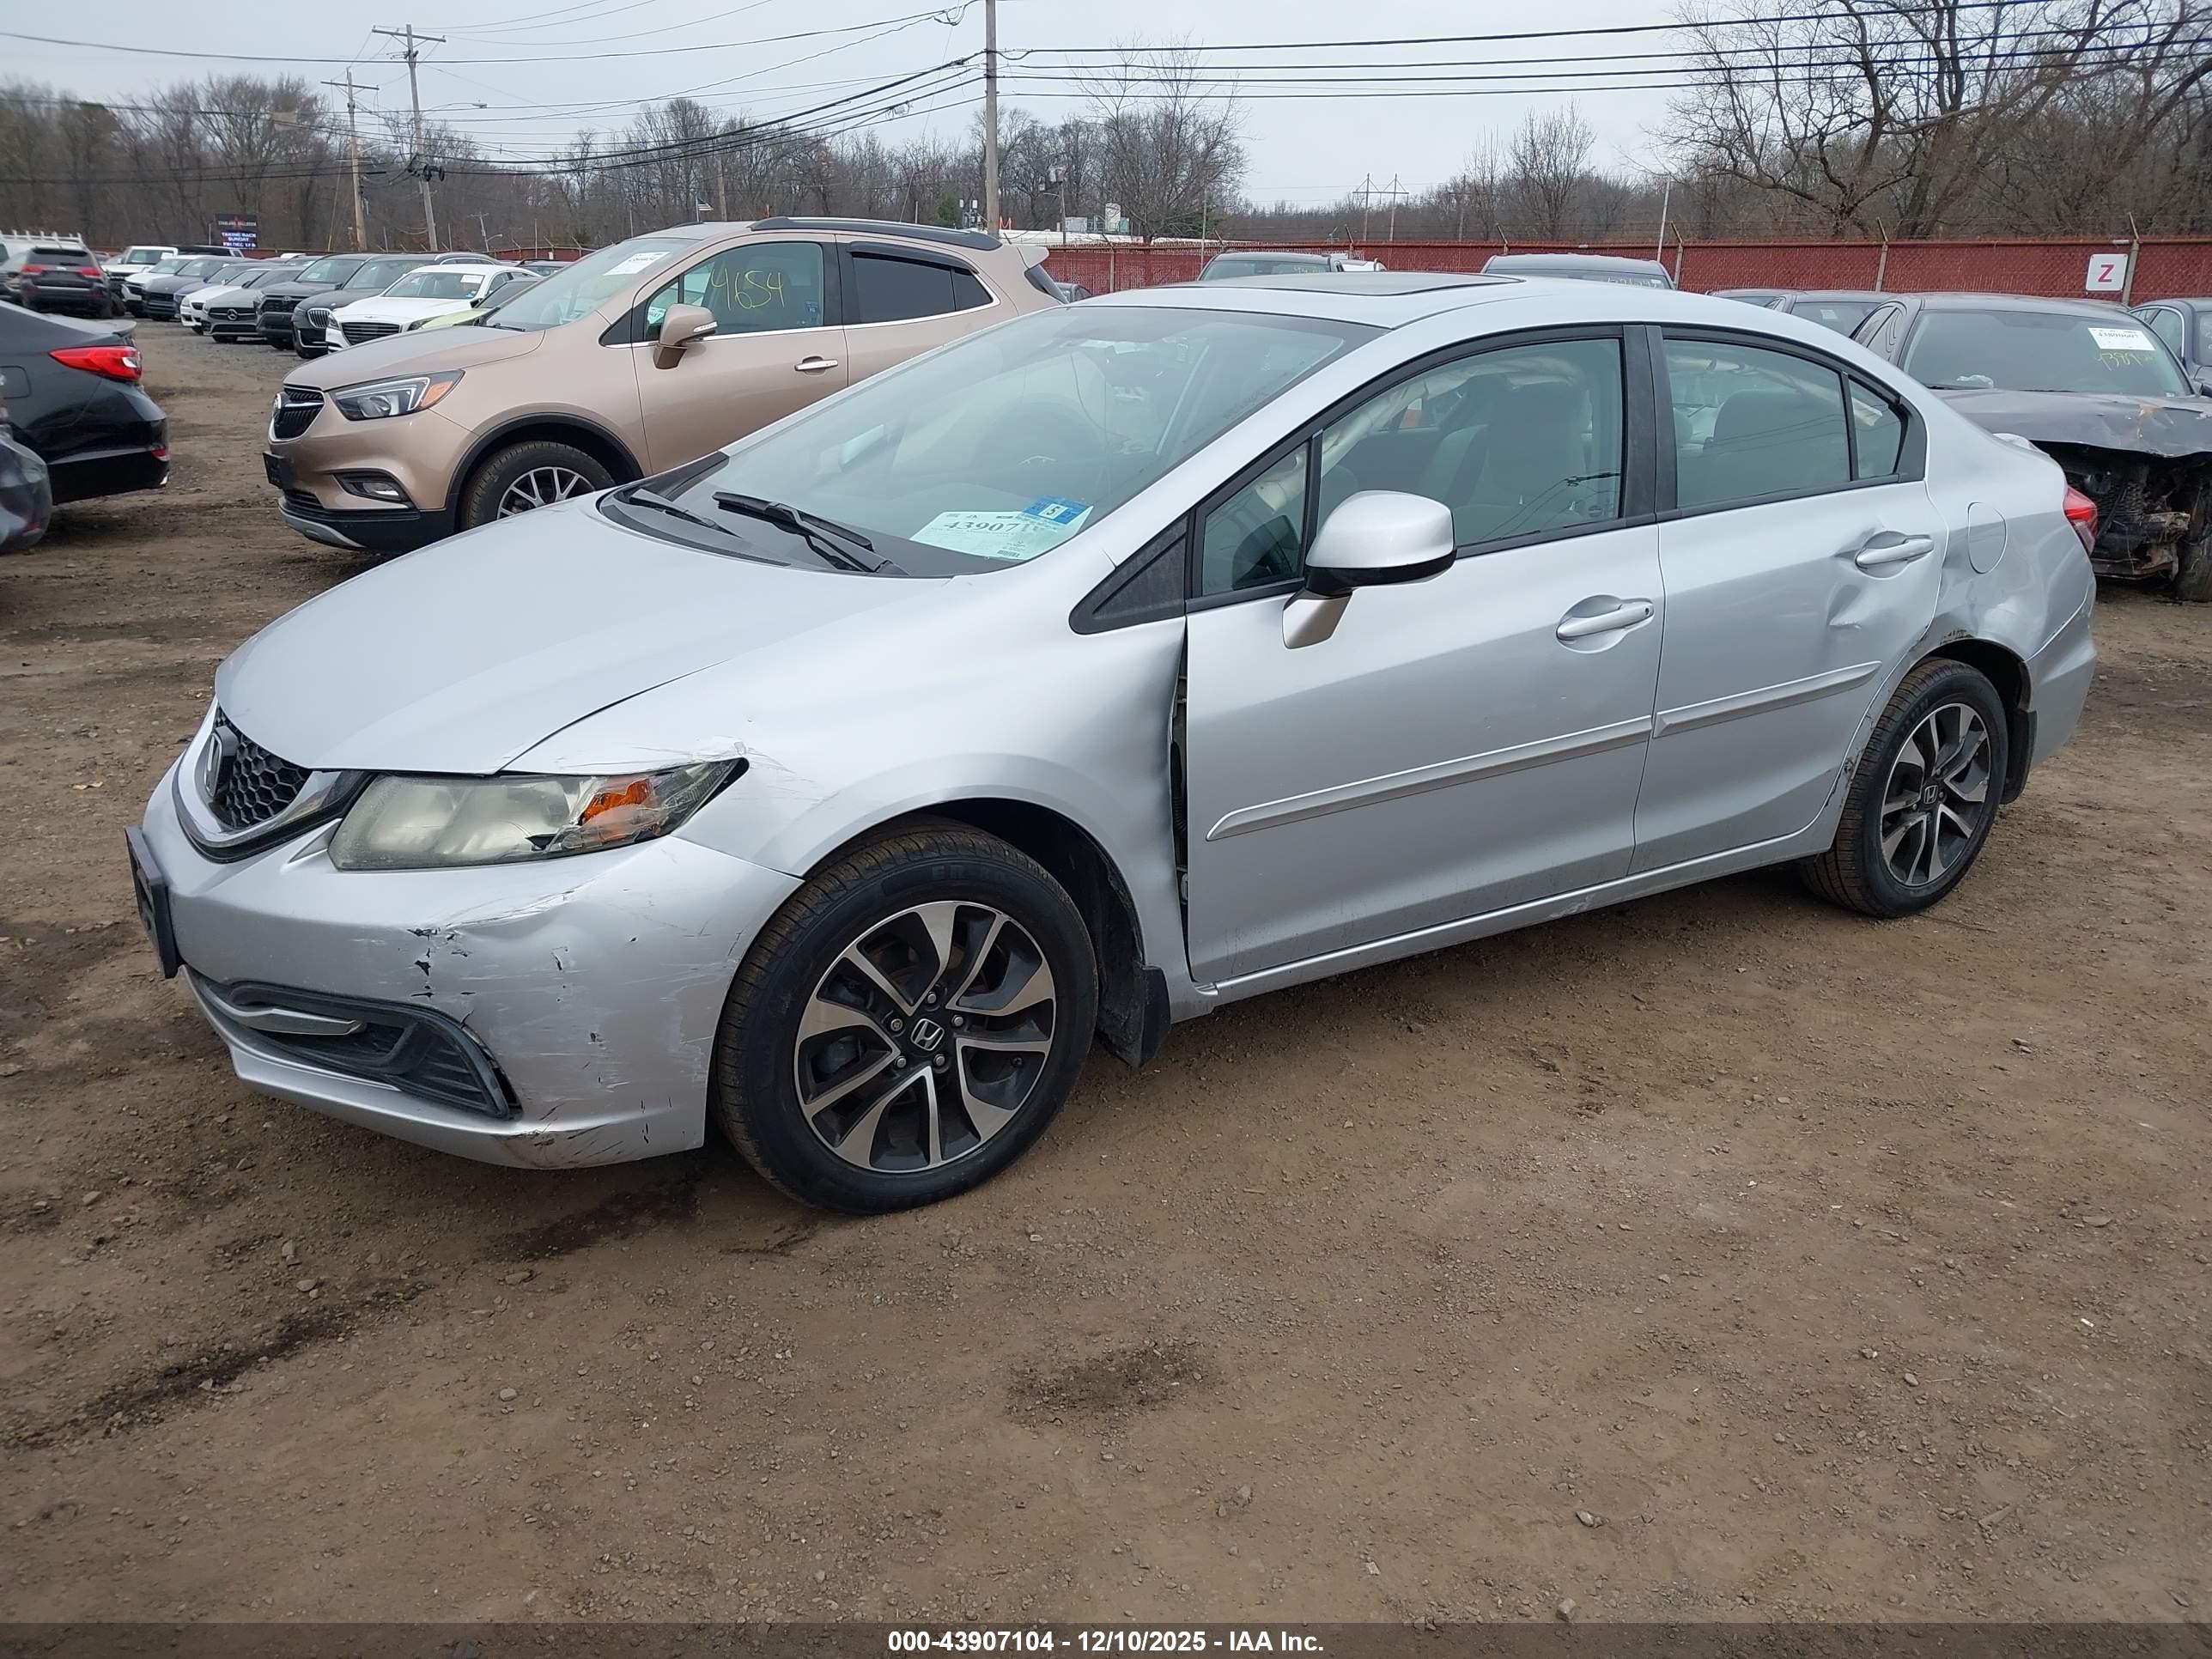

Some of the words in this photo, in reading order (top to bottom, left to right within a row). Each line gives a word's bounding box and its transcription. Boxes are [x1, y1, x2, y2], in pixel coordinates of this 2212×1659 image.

[2098, 264, 2115, 283] Z
[711, 268, 785, 310] 4654
[1046, 506, 1060, 515] 5
